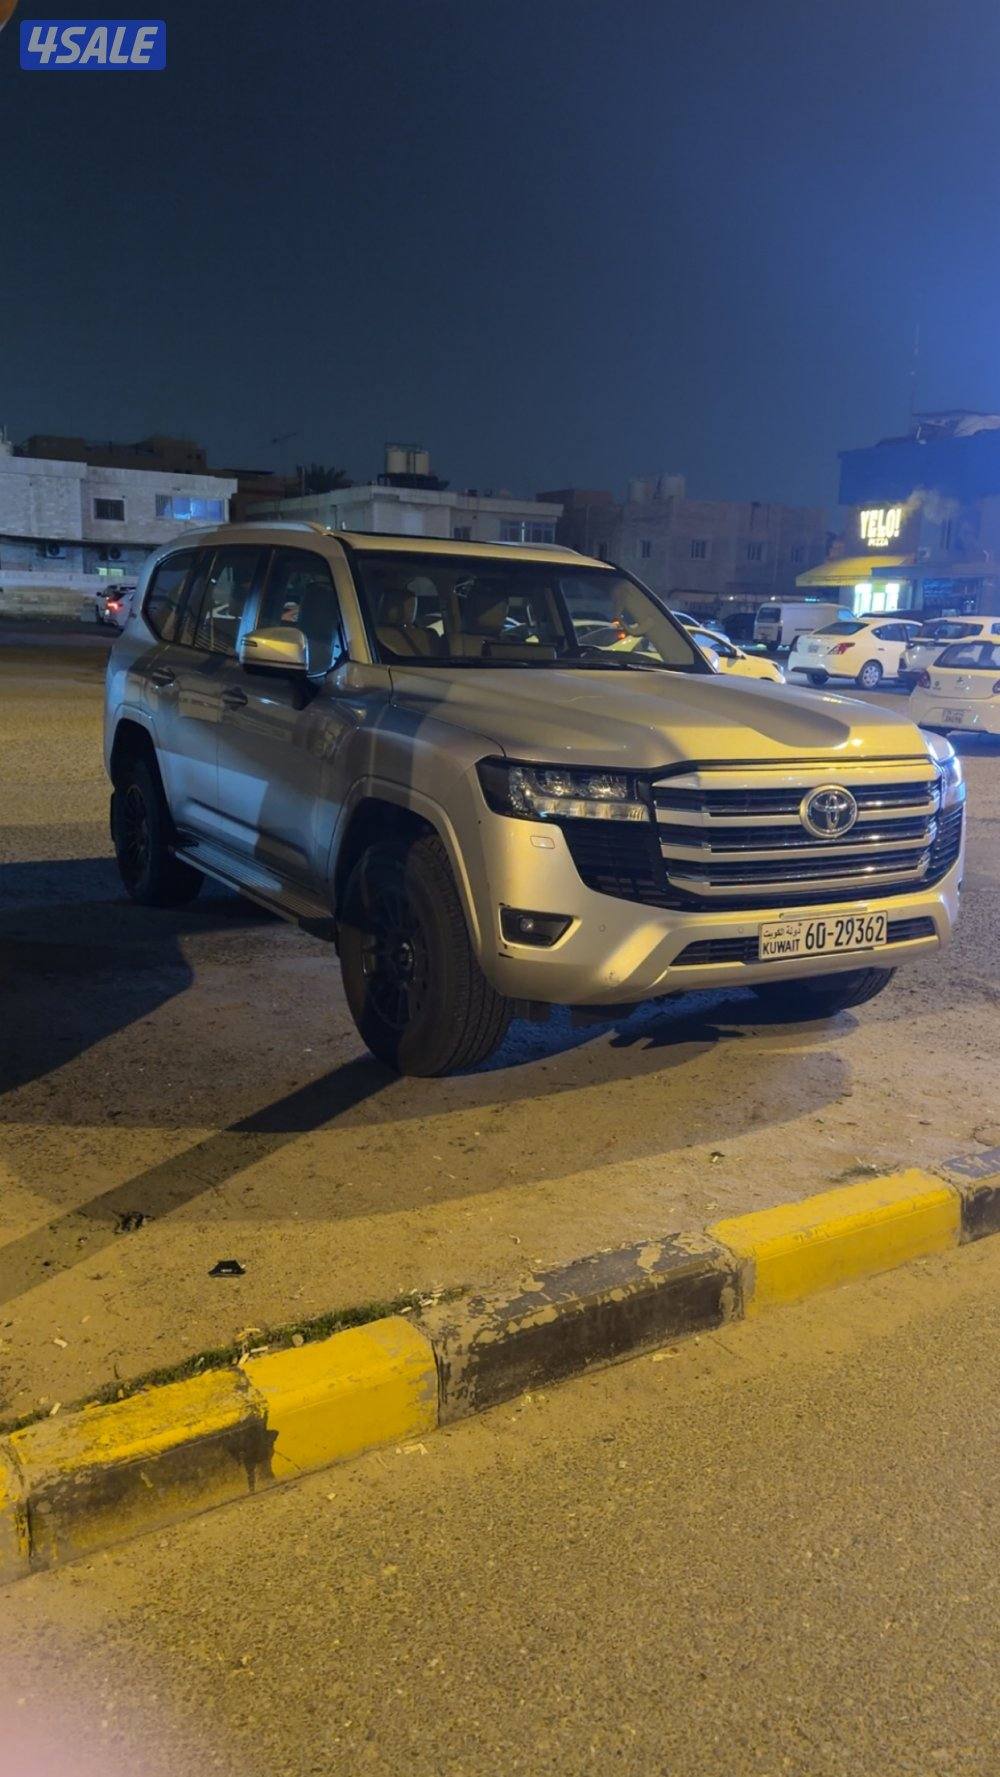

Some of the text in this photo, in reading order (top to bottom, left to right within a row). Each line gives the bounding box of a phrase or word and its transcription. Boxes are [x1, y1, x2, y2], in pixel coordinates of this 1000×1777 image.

[763, 928, 785, 939] الكويت
[805, 915, 885, 950] 60-29362
[763, 939, 800, 954] KUWAIT
